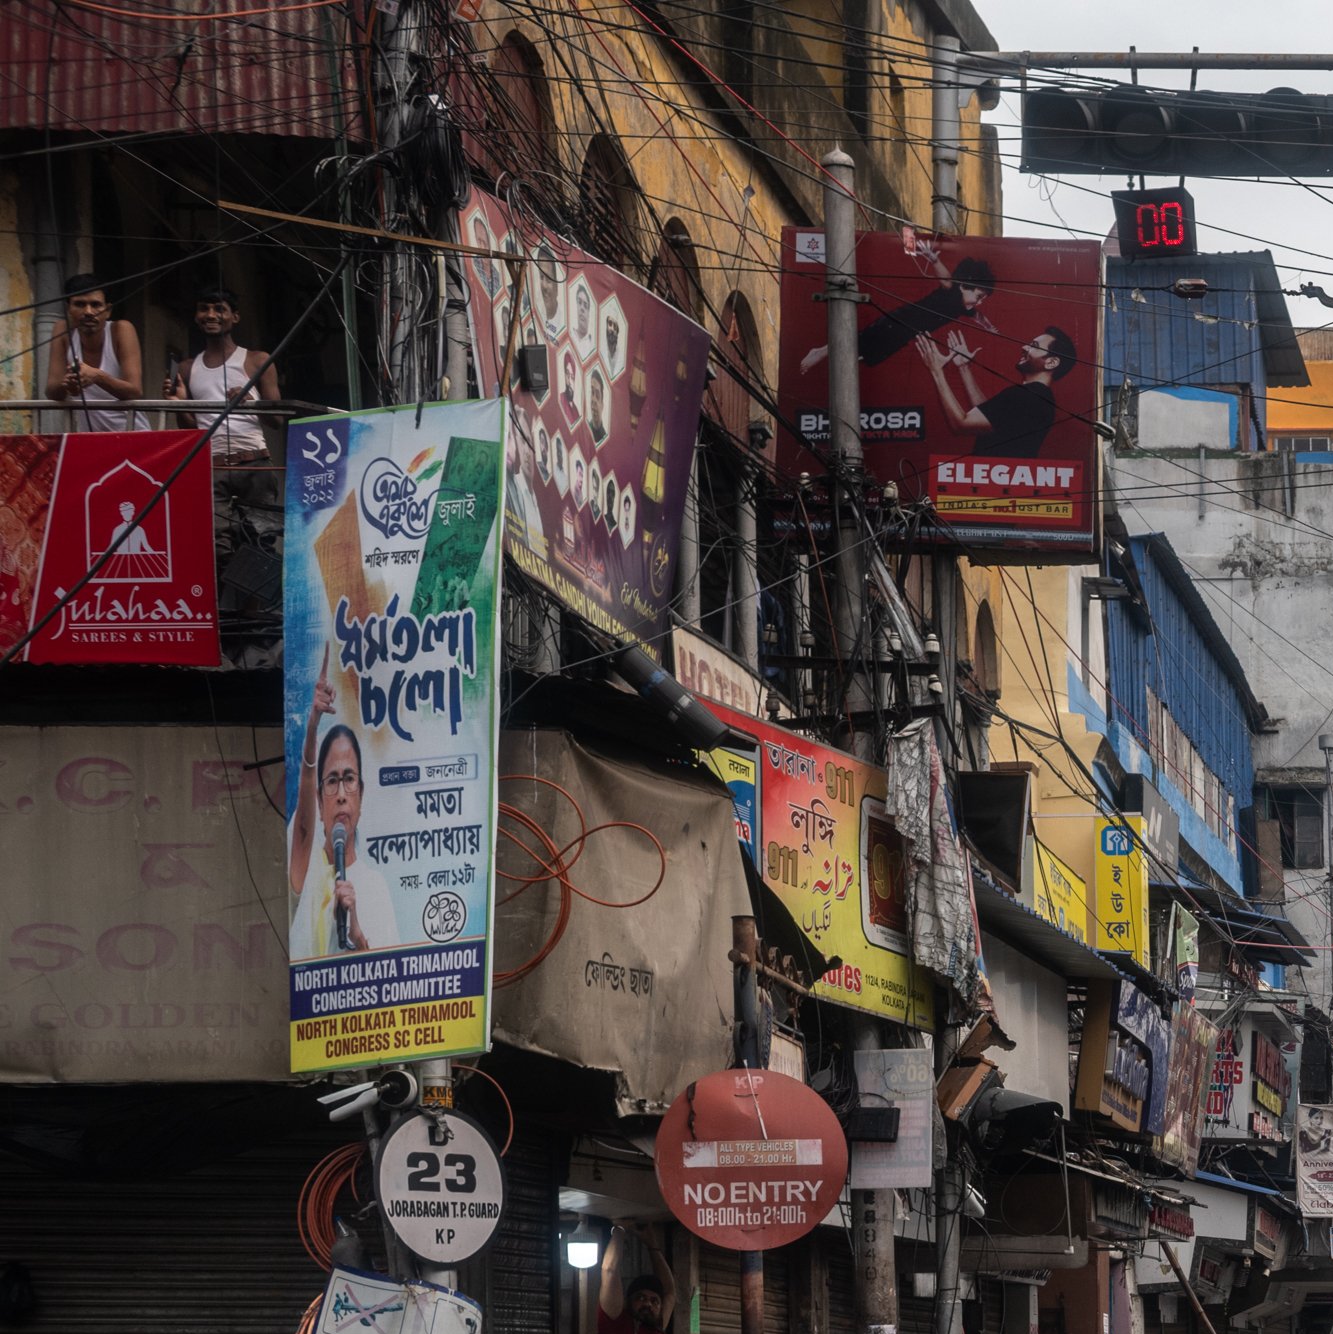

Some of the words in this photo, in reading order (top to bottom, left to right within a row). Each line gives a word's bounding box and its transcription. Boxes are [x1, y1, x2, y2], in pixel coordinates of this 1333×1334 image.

[303, 429, 342, 468] ২১
[304, 470, 336, 491] জুলাই
[937, 461, 1074, 489] ELEGANT
[302, 489, 335, 505] ২০২২
[436, 494, 477, 526] জুলাই
[942, 501, 988, 511] INDIA'S
[1045, 503, 1069, 514] BAR
[511, 538, 554, 591] MAHATMA
[554, 574, 588, 614] GANDHI
[586, 599, 613, 634] YOUTH
[72, 631, 128, 644] SAREES
[132, 631, 143, 643] &
[147, 630, 195, 643] STYLE
[359, 664, 463, 742] চলো
[728, 759, 750, 778] तराना
[764, 740, 816, 784] তারানা
[825, 761, 855, 807] 911
[415, 787, 464, 818] মমতা
[767, 841, 798, 888] 911
[295, 968, 337, 992] NORTH
[341, 958, 398, 984] KOLKATA
[401, 946, 480, 971] TRINAMOOL
[628, 962, 654, 997] ছাতা
[312, 986, 378, 1014] CONGRESS
[382, 975, 461, 1003] COMMITTEE
[881, 977, 907, 997] RABINDRA
[882, 993, 905, 1011] KOLKATA
[297, 1018, 337, 1042] NORTH
[341, 1011, 396, 1035] KOLKATA
[400, 1001, 476, 1026] TRINAMOOL
[325, 1032, 390, 1058] CONGRESS
[393, 1030, 410, 1049] SC
[414, 1026, 445, 1047] CELL
[719, 1143, 734, 1153] ALL
[735, 1142, 756, 1153] TYPE
[757, 1141, 795, 1153] VEHICLES
[719, 1154, 746, 1165] 08.00
[753, 1153, 779, 1164] 21.00
[781, 1153, 795, 1164] Hr.
[406, 1151, 477, 1194] 23
[684, 1183, 726, 1205] NO
[730, 1180, 824, 1204] ENTRY
[388, 1200, 449, 1219] JORABAGAN
